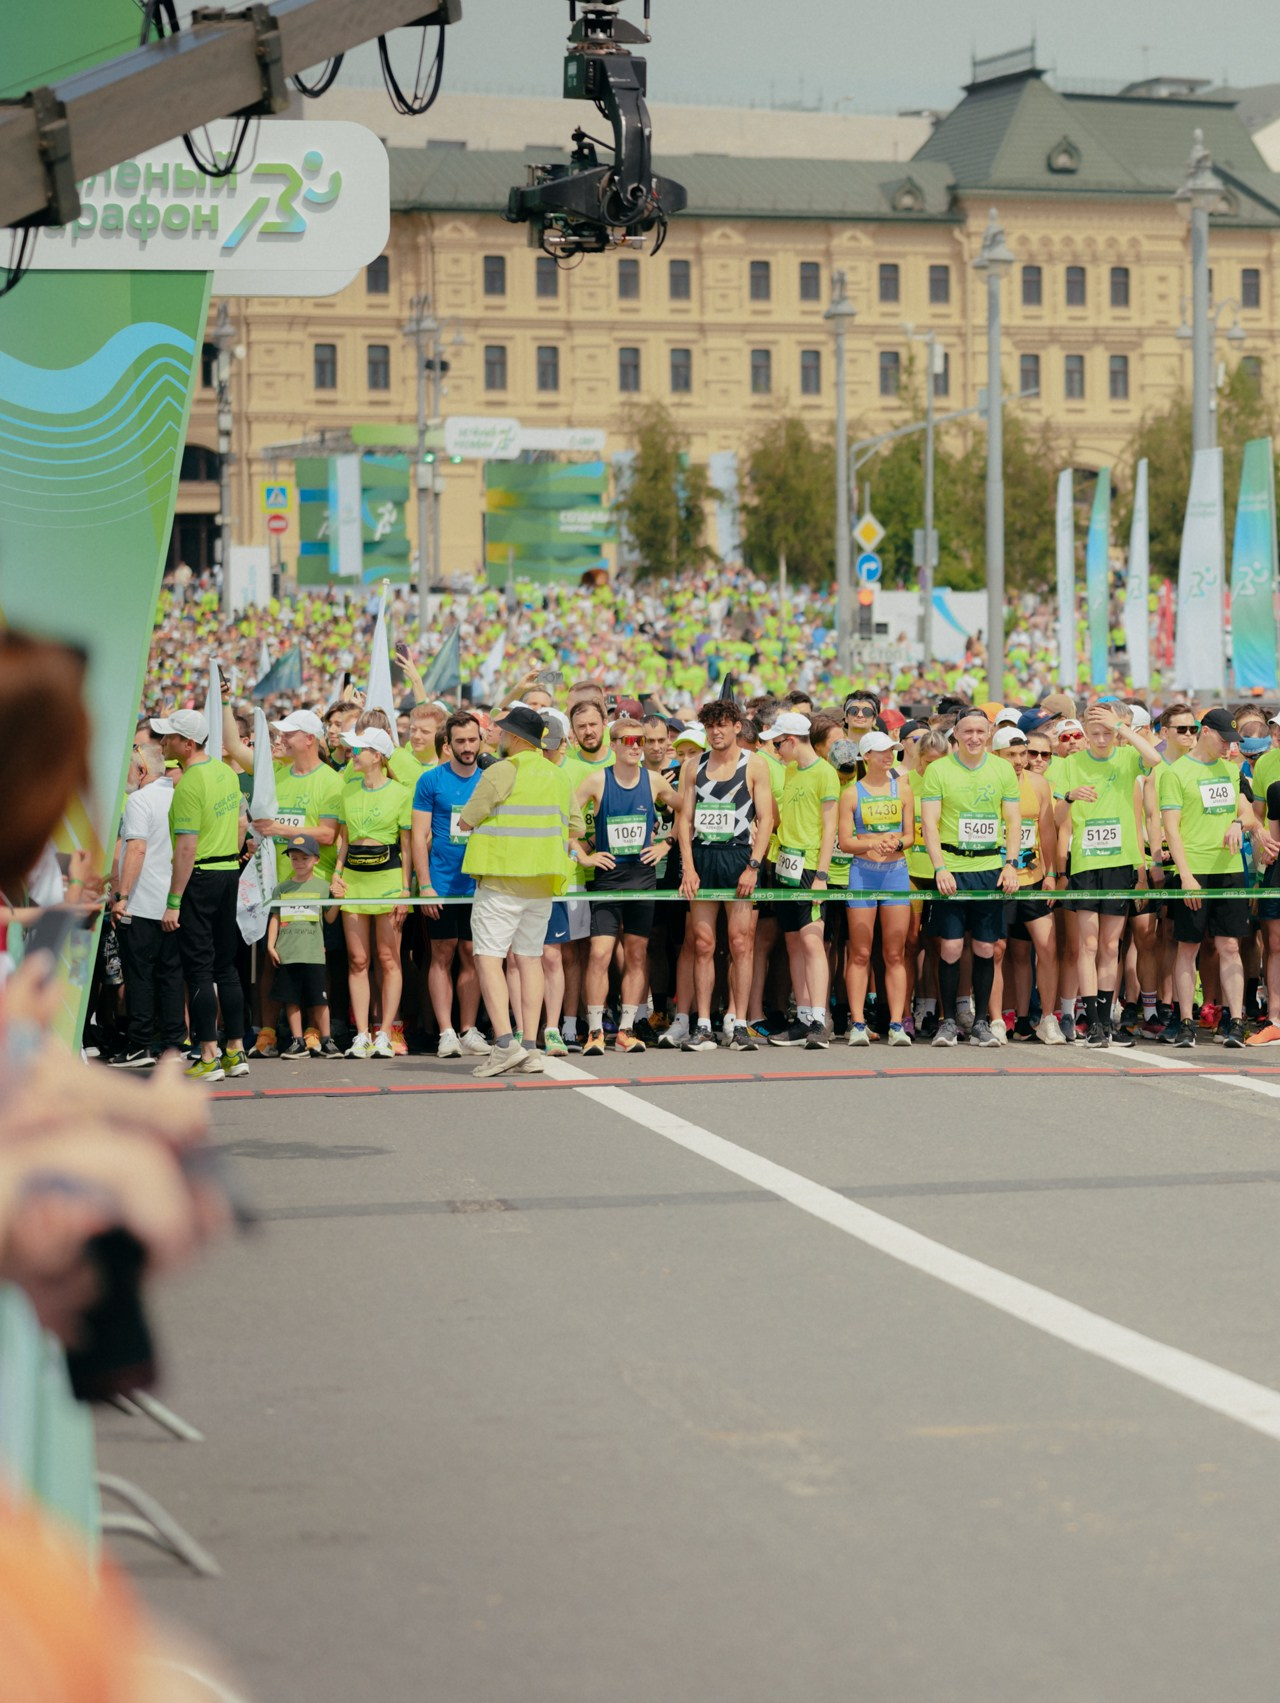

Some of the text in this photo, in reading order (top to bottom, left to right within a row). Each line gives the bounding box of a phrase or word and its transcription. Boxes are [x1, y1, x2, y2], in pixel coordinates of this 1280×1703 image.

[1208, 787, 1229, 799] 248
[867, 803, 898, 817] 1430
[700, 813, 728, 825] 2231
[614, 826, 643, 839] 1067
[964, 822, 994, 835] 5405
[1087, 829, 1117, 841] 5125
